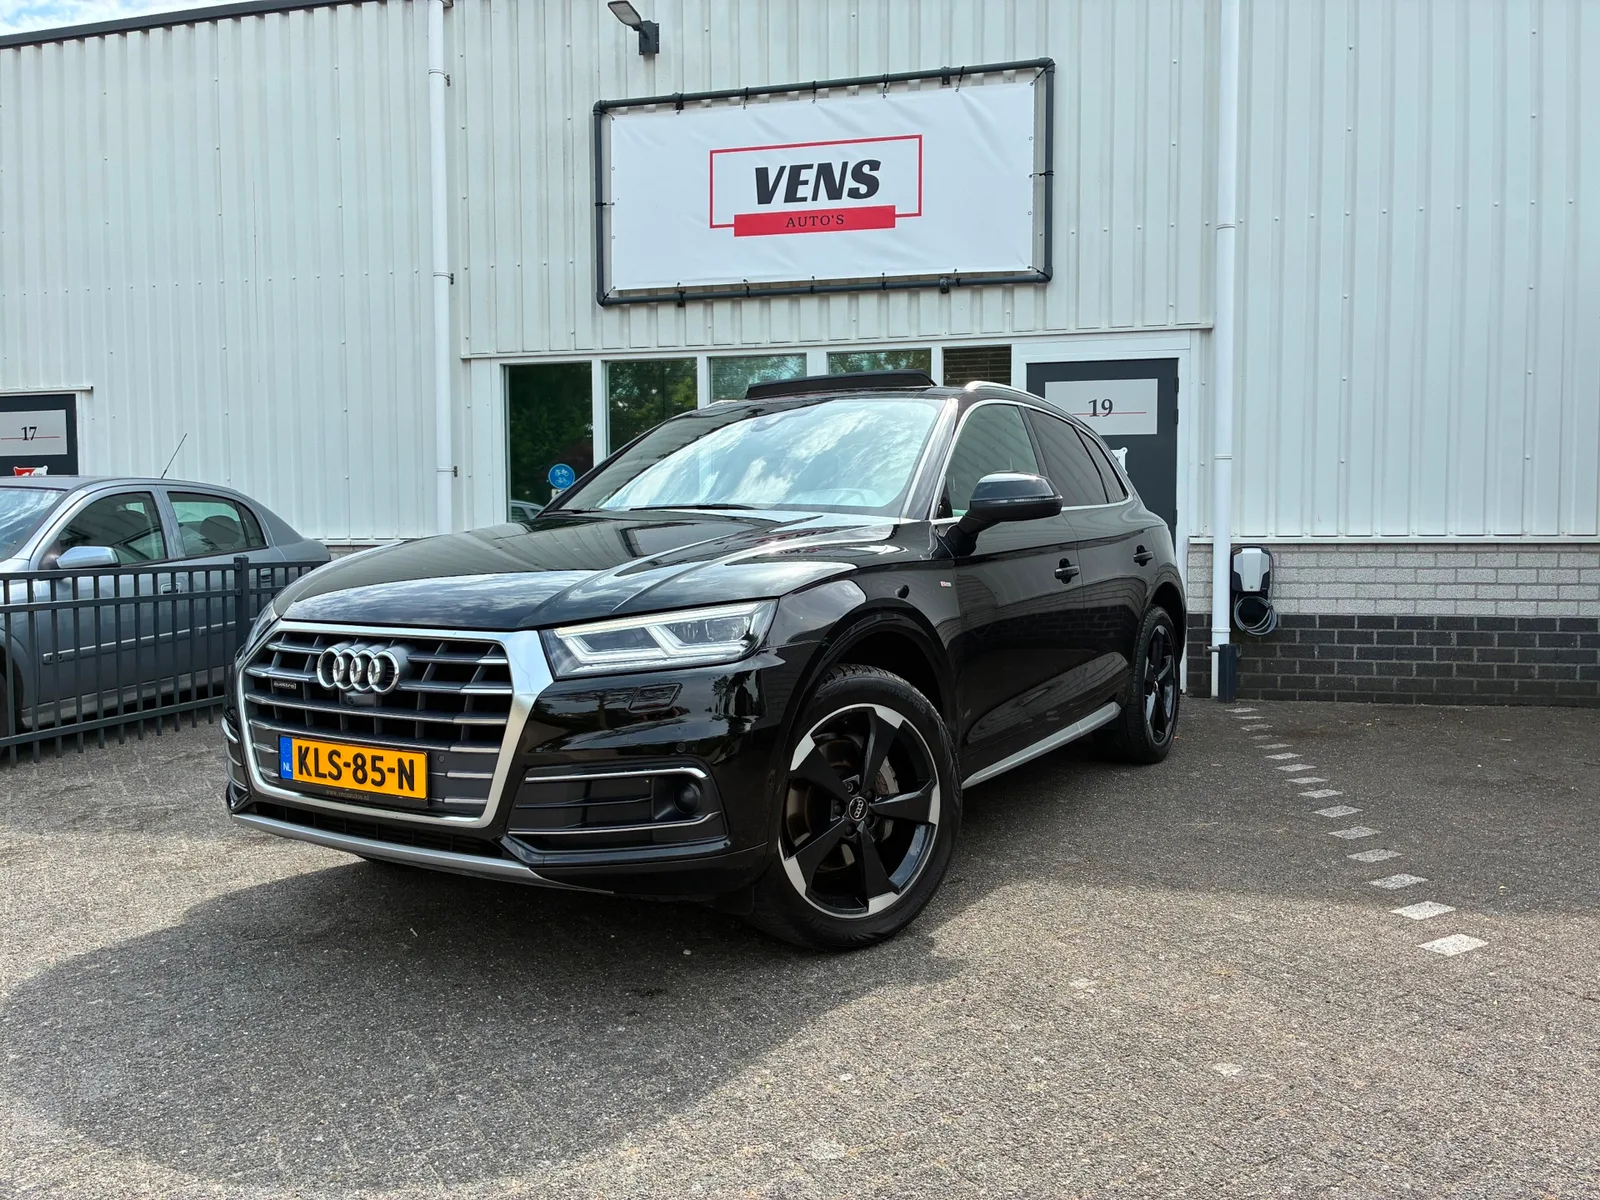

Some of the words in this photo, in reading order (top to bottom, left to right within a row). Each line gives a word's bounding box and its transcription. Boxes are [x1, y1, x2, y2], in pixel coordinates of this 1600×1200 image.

[755, 159, 882, 205] VENS
[785, 214, 845, 228] AUTO'S
[1088, 398, 1113, 417] 19
[21, 426, 38, 441] 17
[282, 762, 292, 772] NL
[297, 745, 415, 792] KLS-85-N
